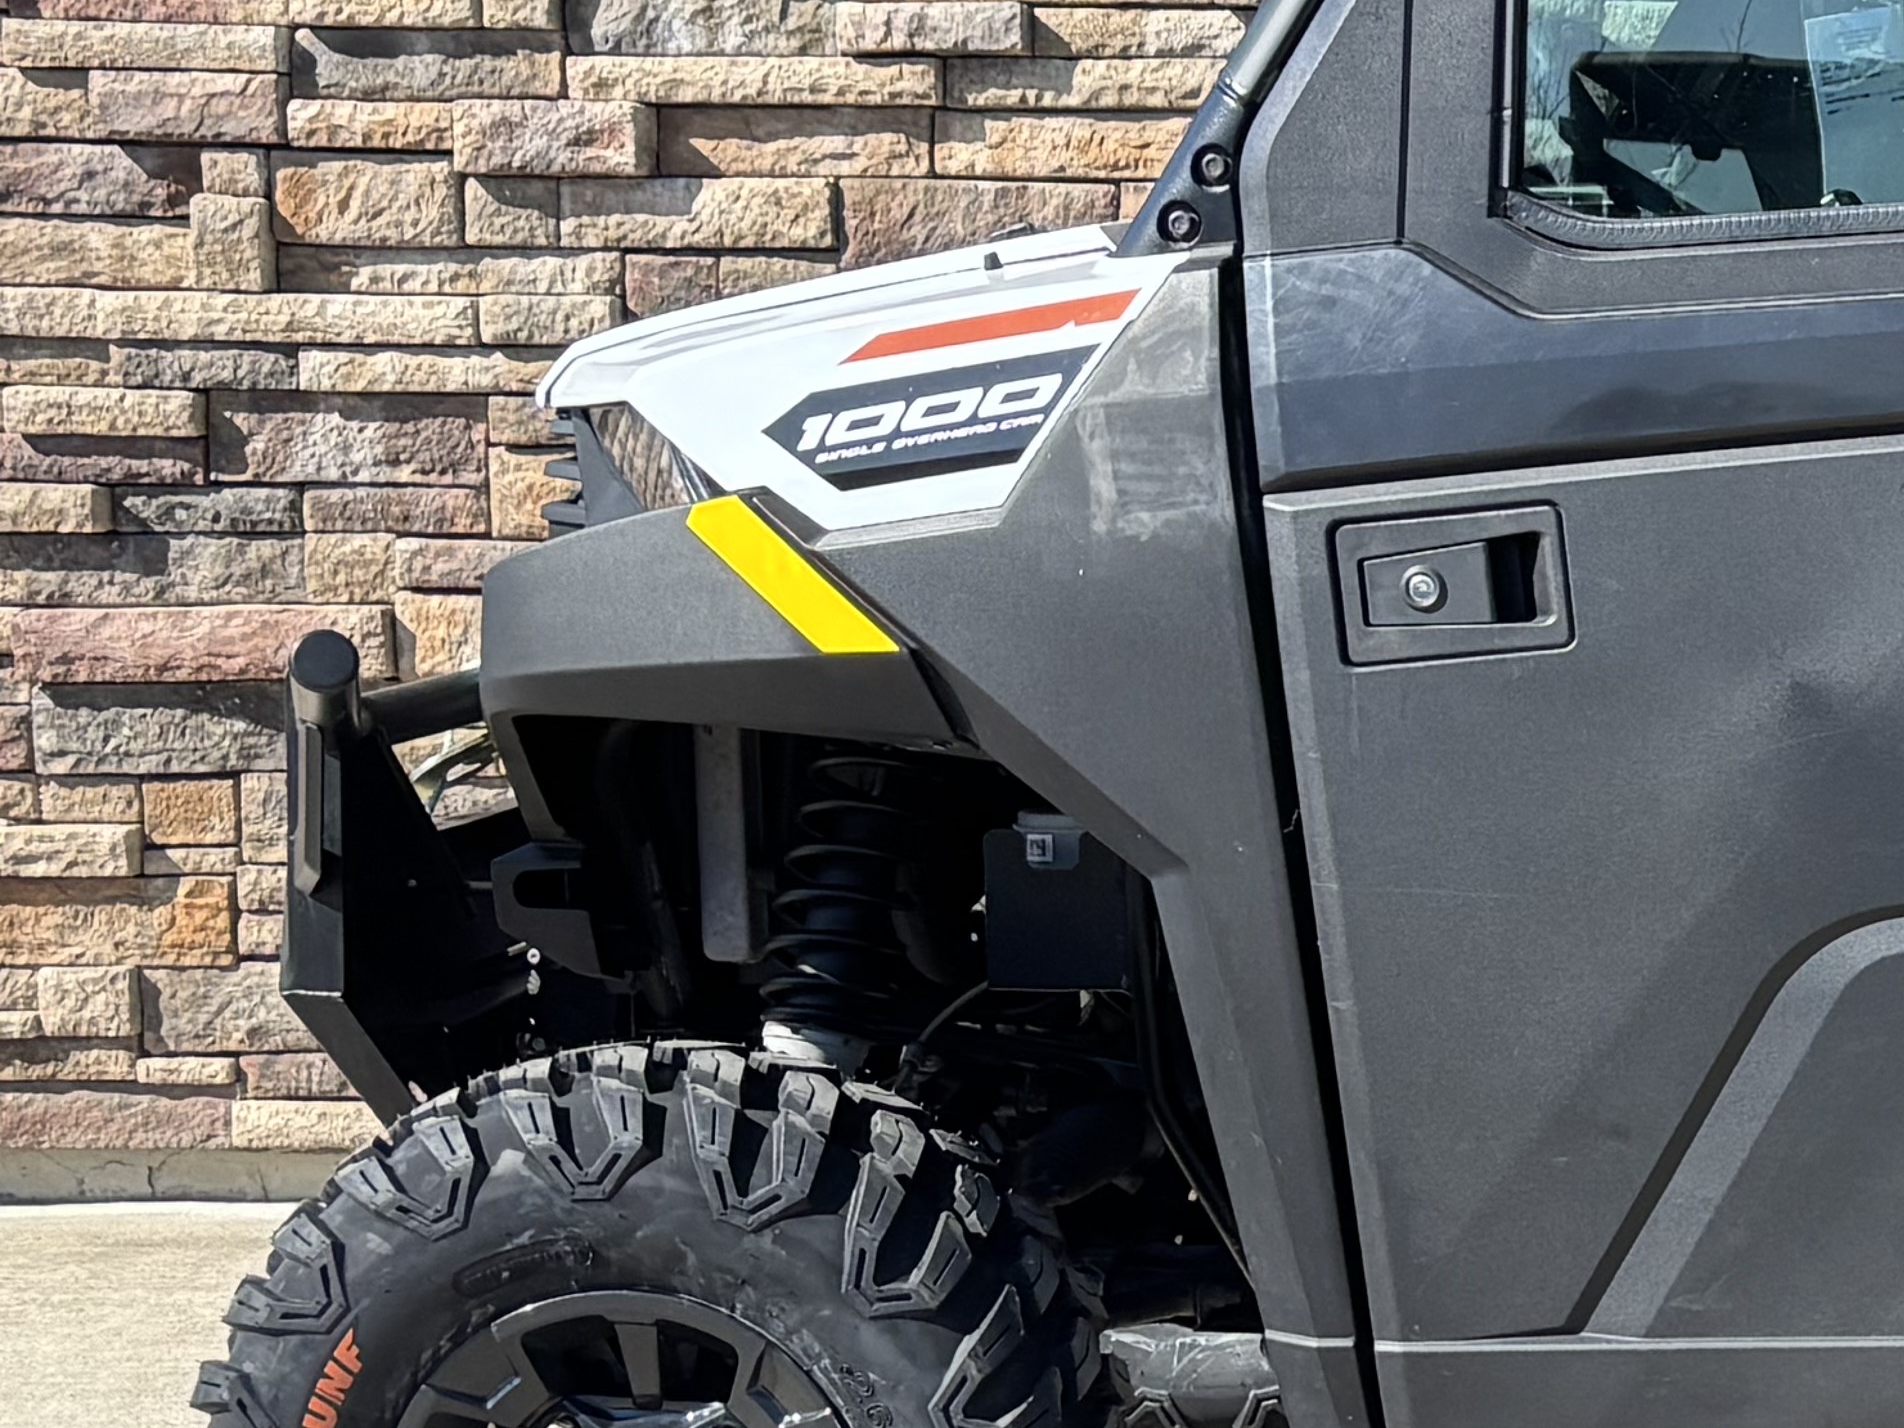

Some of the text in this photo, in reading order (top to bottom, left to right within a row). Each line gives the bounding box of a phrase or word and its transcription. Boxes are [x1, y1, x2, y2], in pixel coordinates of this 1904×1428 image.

[797, 373, 1062, 451] 1000
[814, 441, 887, 464] SINGLE
[891, 422, 998, 450] OVERHEAD
